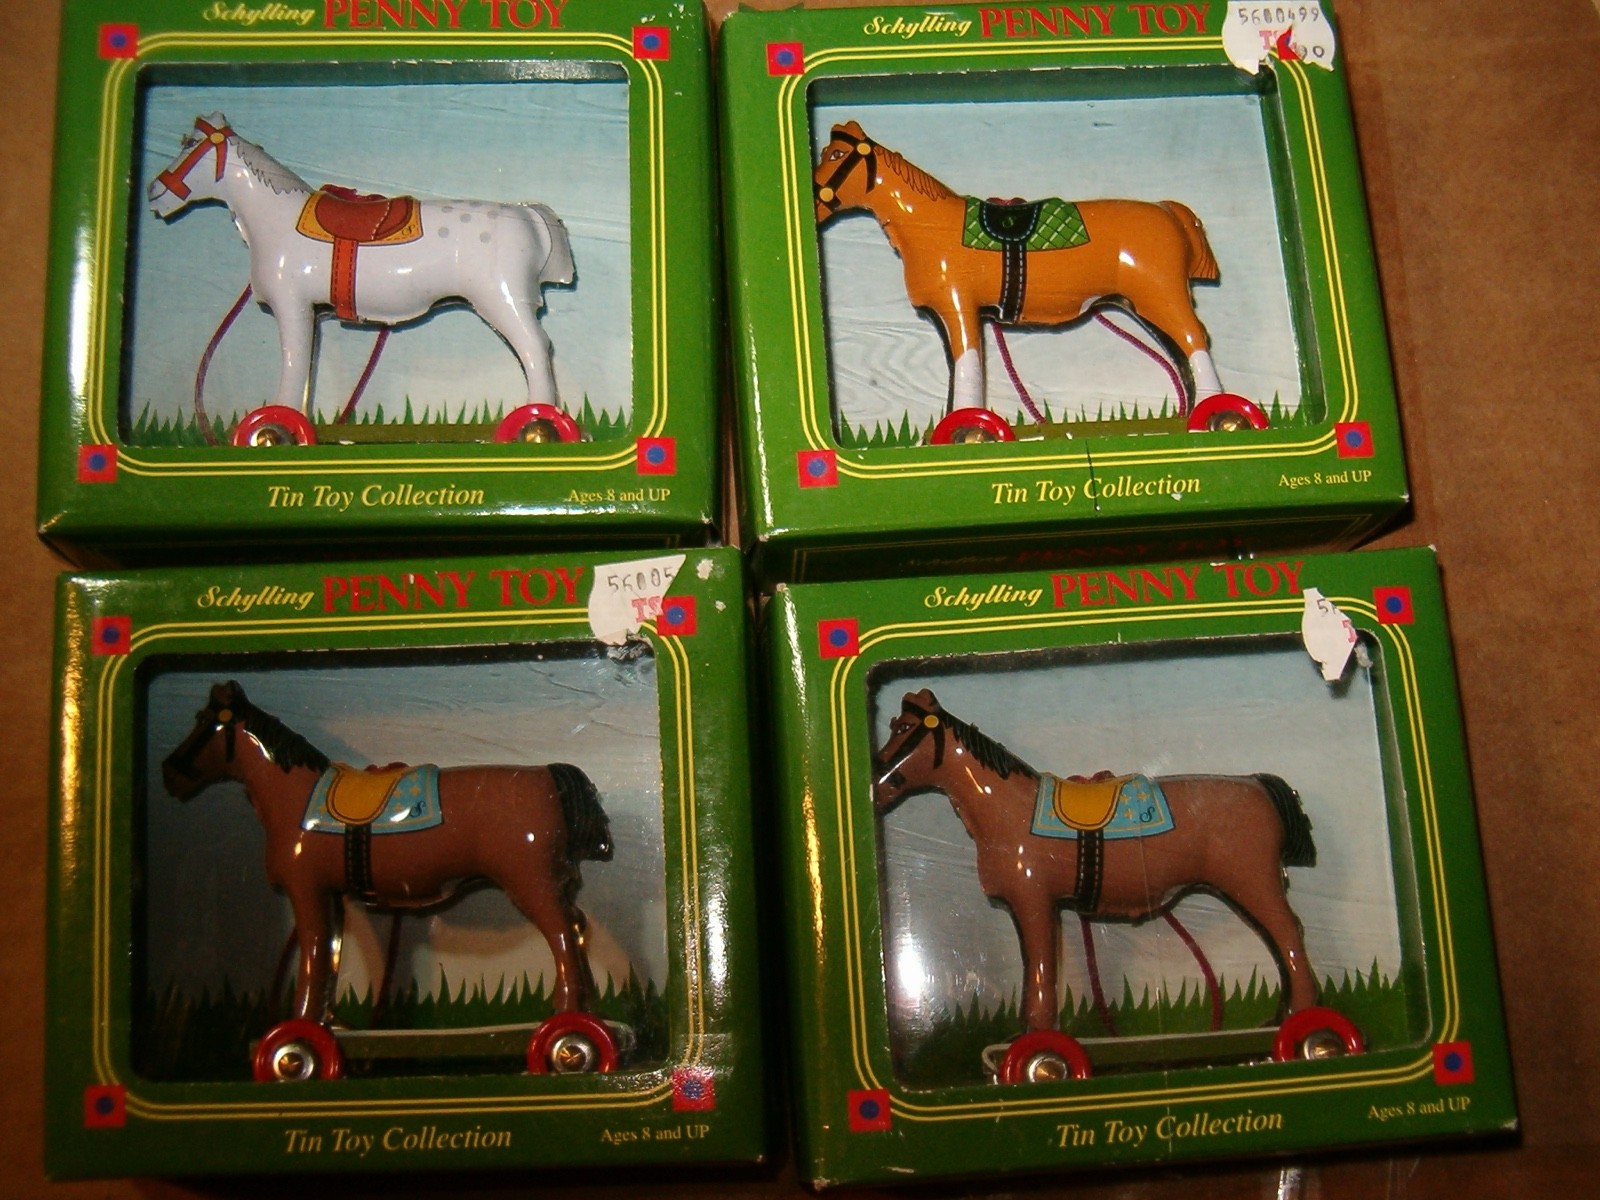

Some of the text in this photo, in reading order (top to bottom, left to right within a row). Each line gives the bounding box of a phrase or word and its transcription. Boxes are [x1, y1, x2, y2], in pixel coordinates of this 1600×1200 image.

[202, 0, 568, 29] Schylling PENNY TOY
[863, 2, 1213, 40] Schylling PENNY TOY
[991, 474, 1201, 506] Tin Toy Collection
[1278, 469, 1373, 489] Ages 8 and UP
[268, 483, 485, 512] Tin Toy Collection
[568, 488, 671, 506] Ages 8 and UP
[197, 566, 585, 613] Schylling PENNY TOY
[924, 560, 1305, 612] Schylling PENNY TOY
[1368, 1097, 1471, 1121] Ages 8 and UP
[284, 1125, 512, 1157] Tin Toy Collection
[600, 1124, 710, 1145] Ages 8 and UP
[1057, 1110, 1284, 1147] Tin Toy Collection
